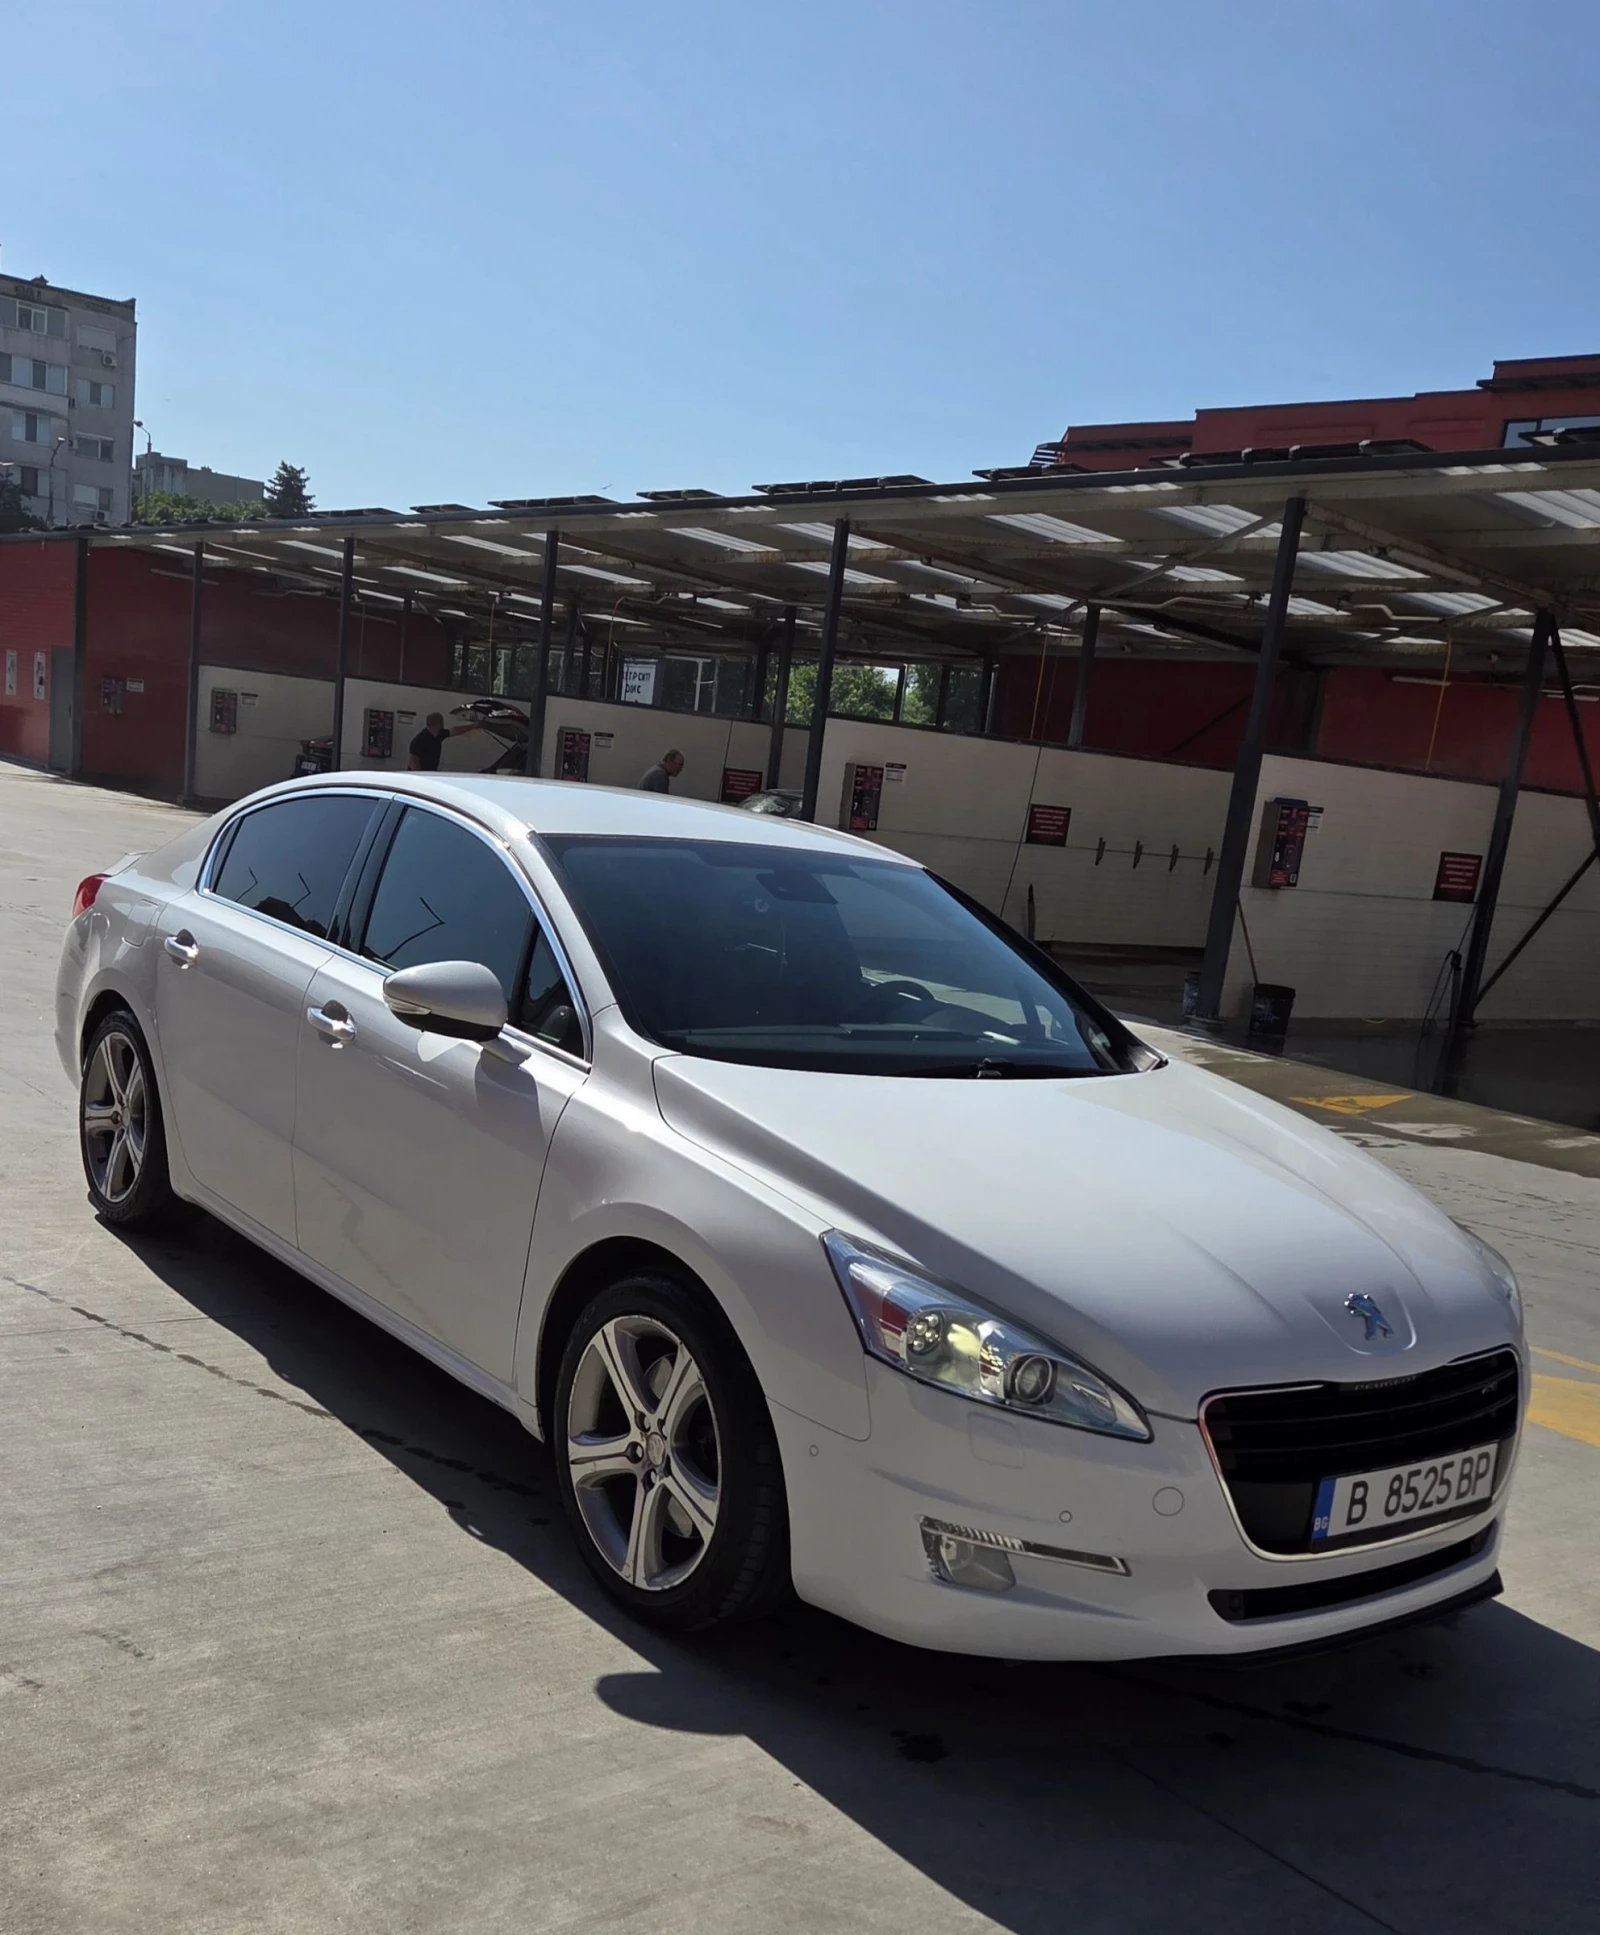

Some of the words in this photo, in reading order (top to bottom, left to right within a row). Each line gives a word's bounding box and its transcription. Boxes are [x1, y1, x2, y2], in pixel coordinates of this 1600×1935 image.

[1346, 1480, 1369, 1526] B
[1384, 1461, 1455, 1517] 8525
[1456, 1451, 1491, 1500] BP
[1313, 1516, 1329, 1531] BG
